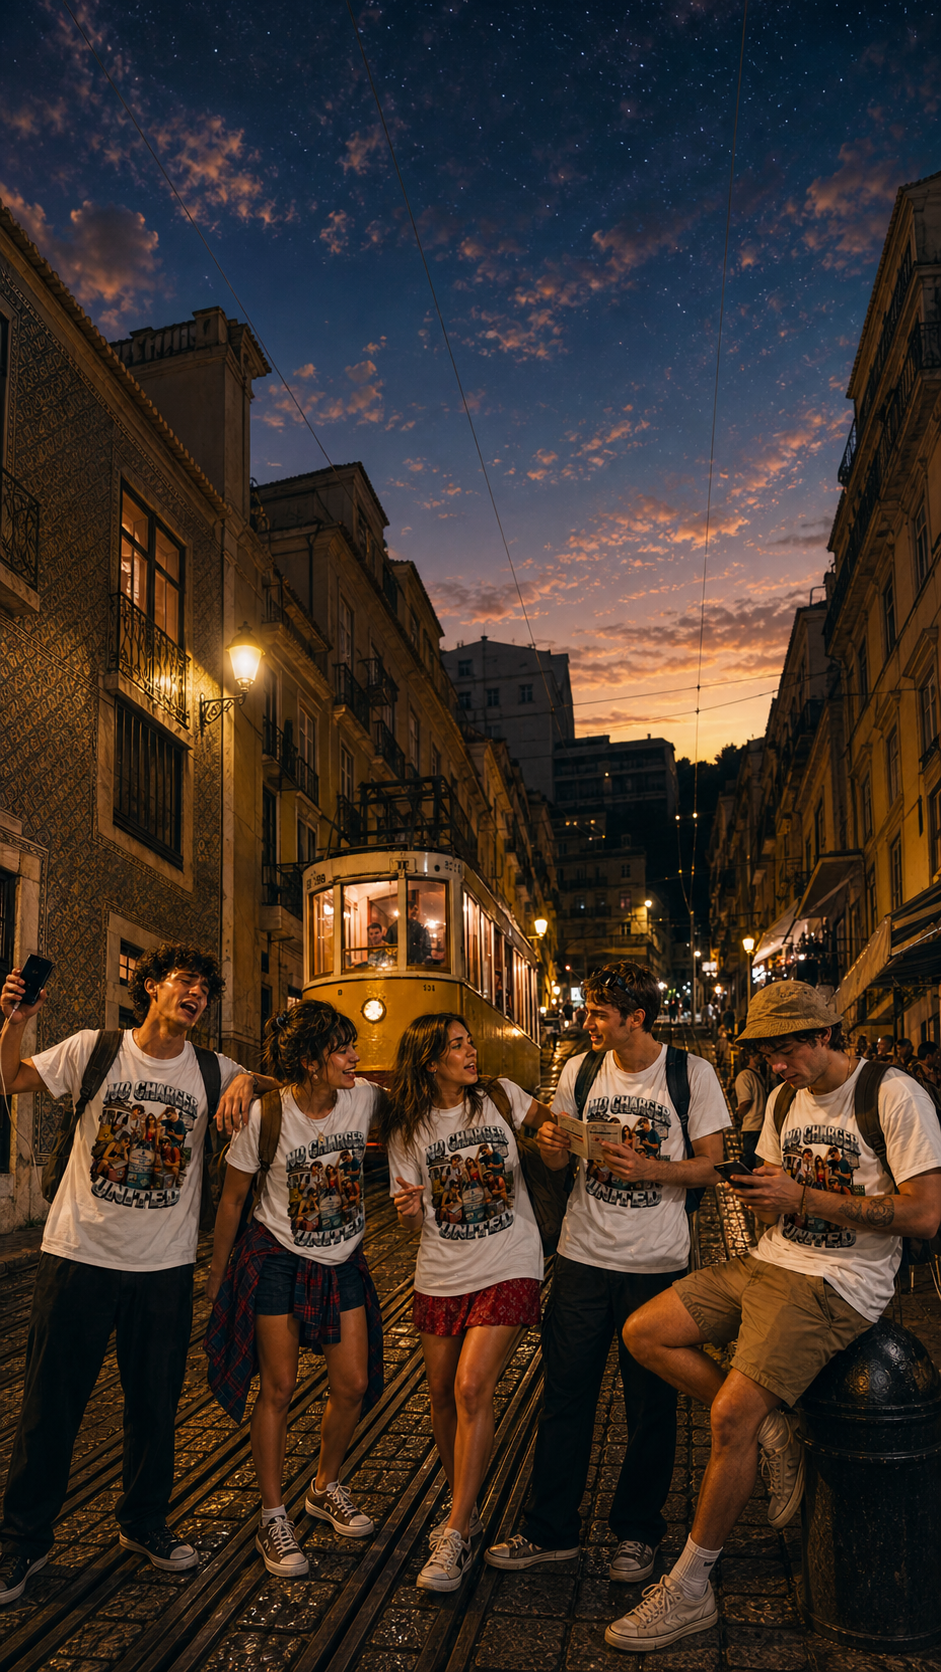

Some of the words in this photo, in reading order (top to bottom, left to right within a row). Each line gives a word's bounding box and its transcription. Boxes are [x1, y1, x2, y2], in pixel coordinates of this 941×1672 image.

[103, 1081, 132, 1106] NO
[133, 1080, 198, 1119] CHARGER
[587, 1096, 608, 1120] NO
[610, 1094, 671, 1127] CHARGER
[286, 1146, 306, 1173] NO
[308, 1131, 365, 1159] CHARGER
[425, 1139, 445, 1165] NO
[447, 1126, 509, 1152] CHARGER
[782, 1127, 801, 1151] NO
[803, 1125, 861, 1155] CHARGER
[91, 1177, 180, 1209] UNITED
[586, 1177, 662, 1208] UNITED
[294, 1216, 365, 1247] UNITED
[439, 1212, 514, 1240] UNITED
[782, 1222, 856, 1248] UNITED
